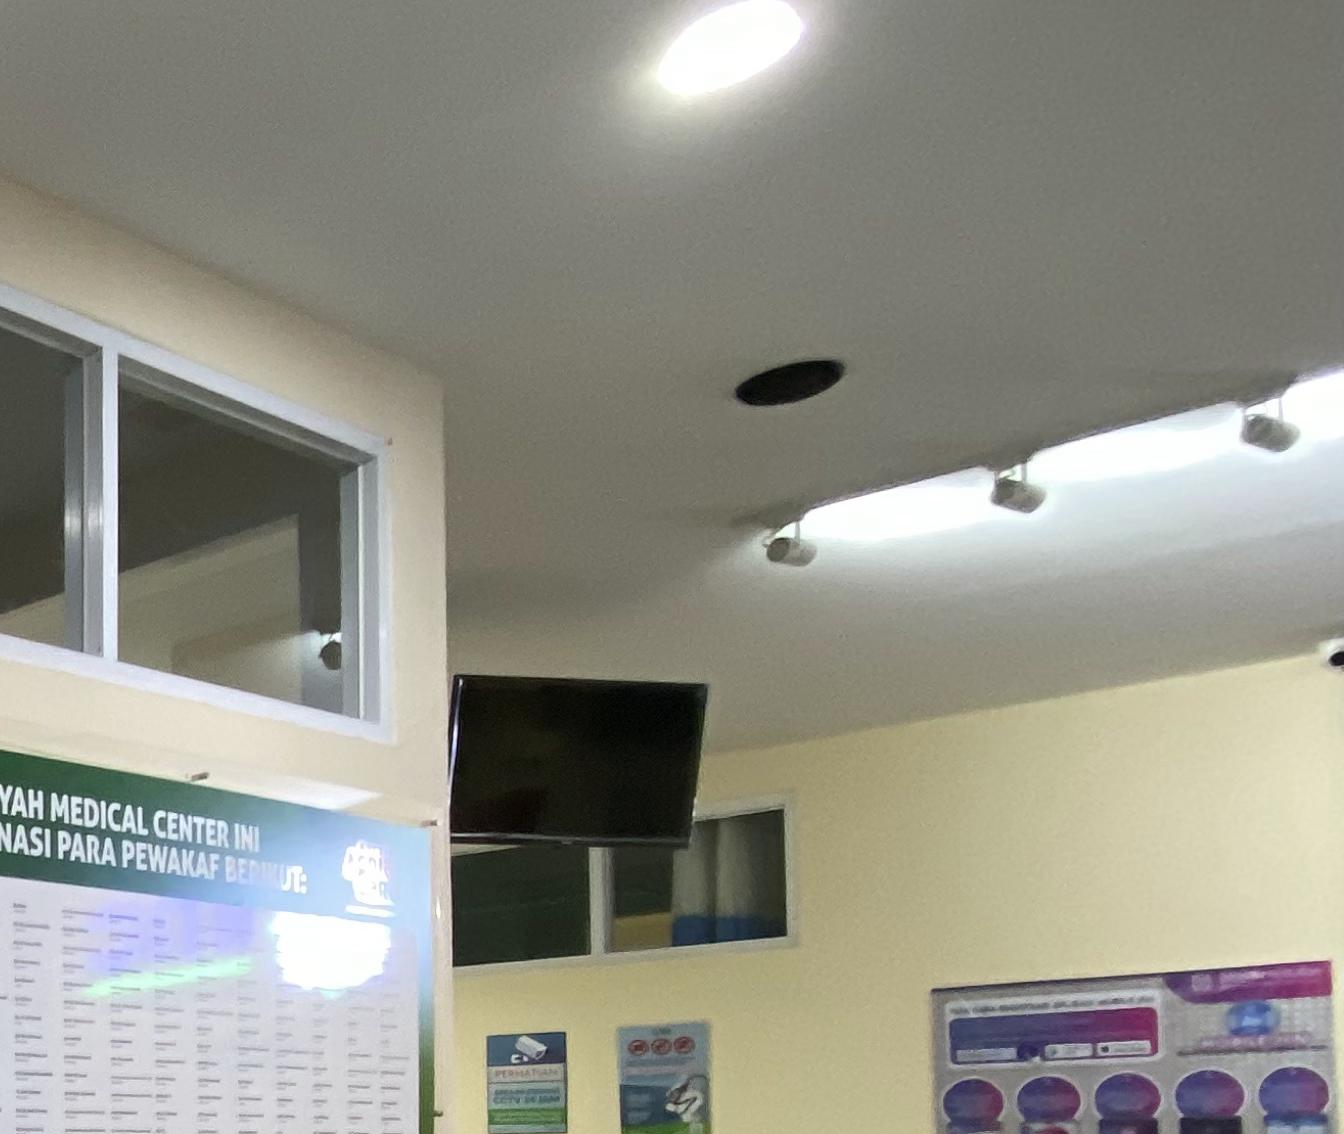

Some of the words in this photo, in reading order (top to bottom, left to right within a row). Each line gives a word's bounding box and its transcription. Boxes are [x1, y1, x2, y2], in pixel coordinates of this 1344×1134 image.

[49, 791, 149, 837] MEDICAL
[152, 809, 230, 849] CENTER
[233, 822, 260, 853] INI
[57, 830, 117, 868] PARA
[121, 839, 220, 881] PEWAKAF
